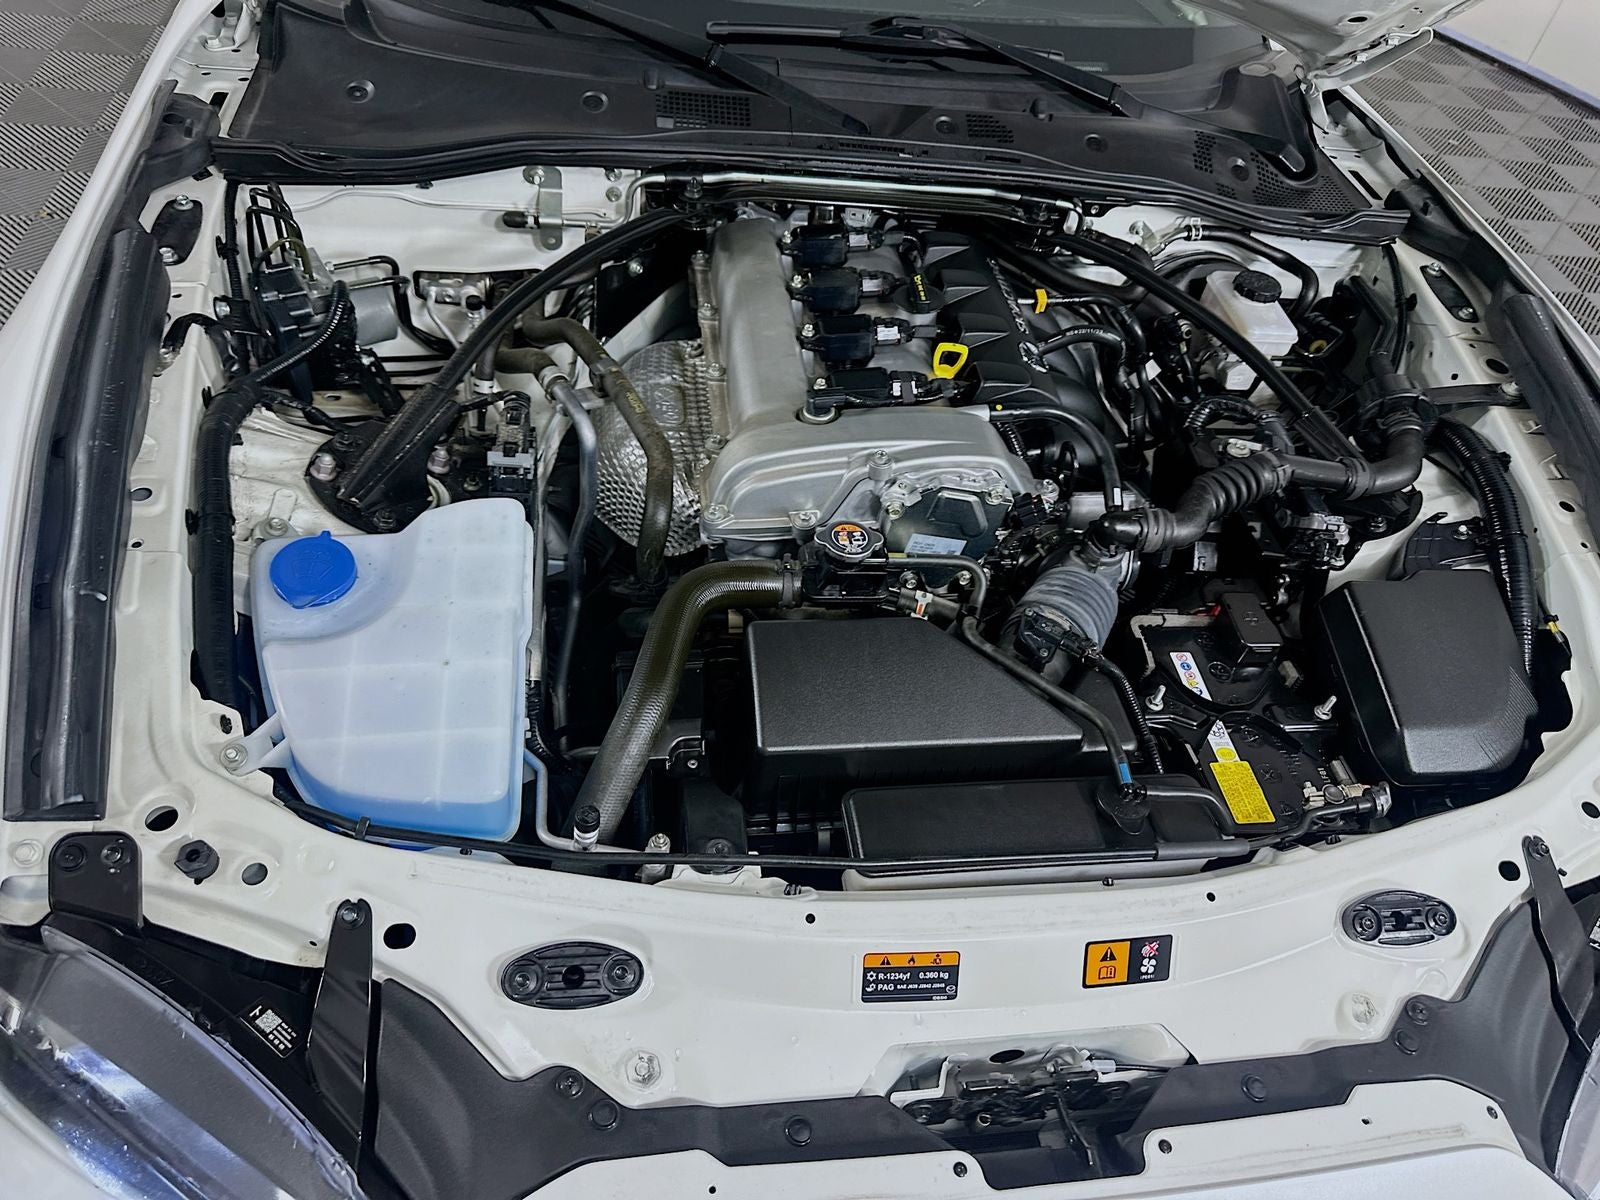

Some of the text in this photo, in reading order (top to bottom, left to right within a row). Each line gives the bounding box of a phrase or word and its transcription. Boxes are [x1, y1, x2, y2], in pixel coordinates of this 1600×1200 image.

[878, 971, 949, 981] R-1234yf 0.360 kg
[877, 983, 894, 991] PAG
